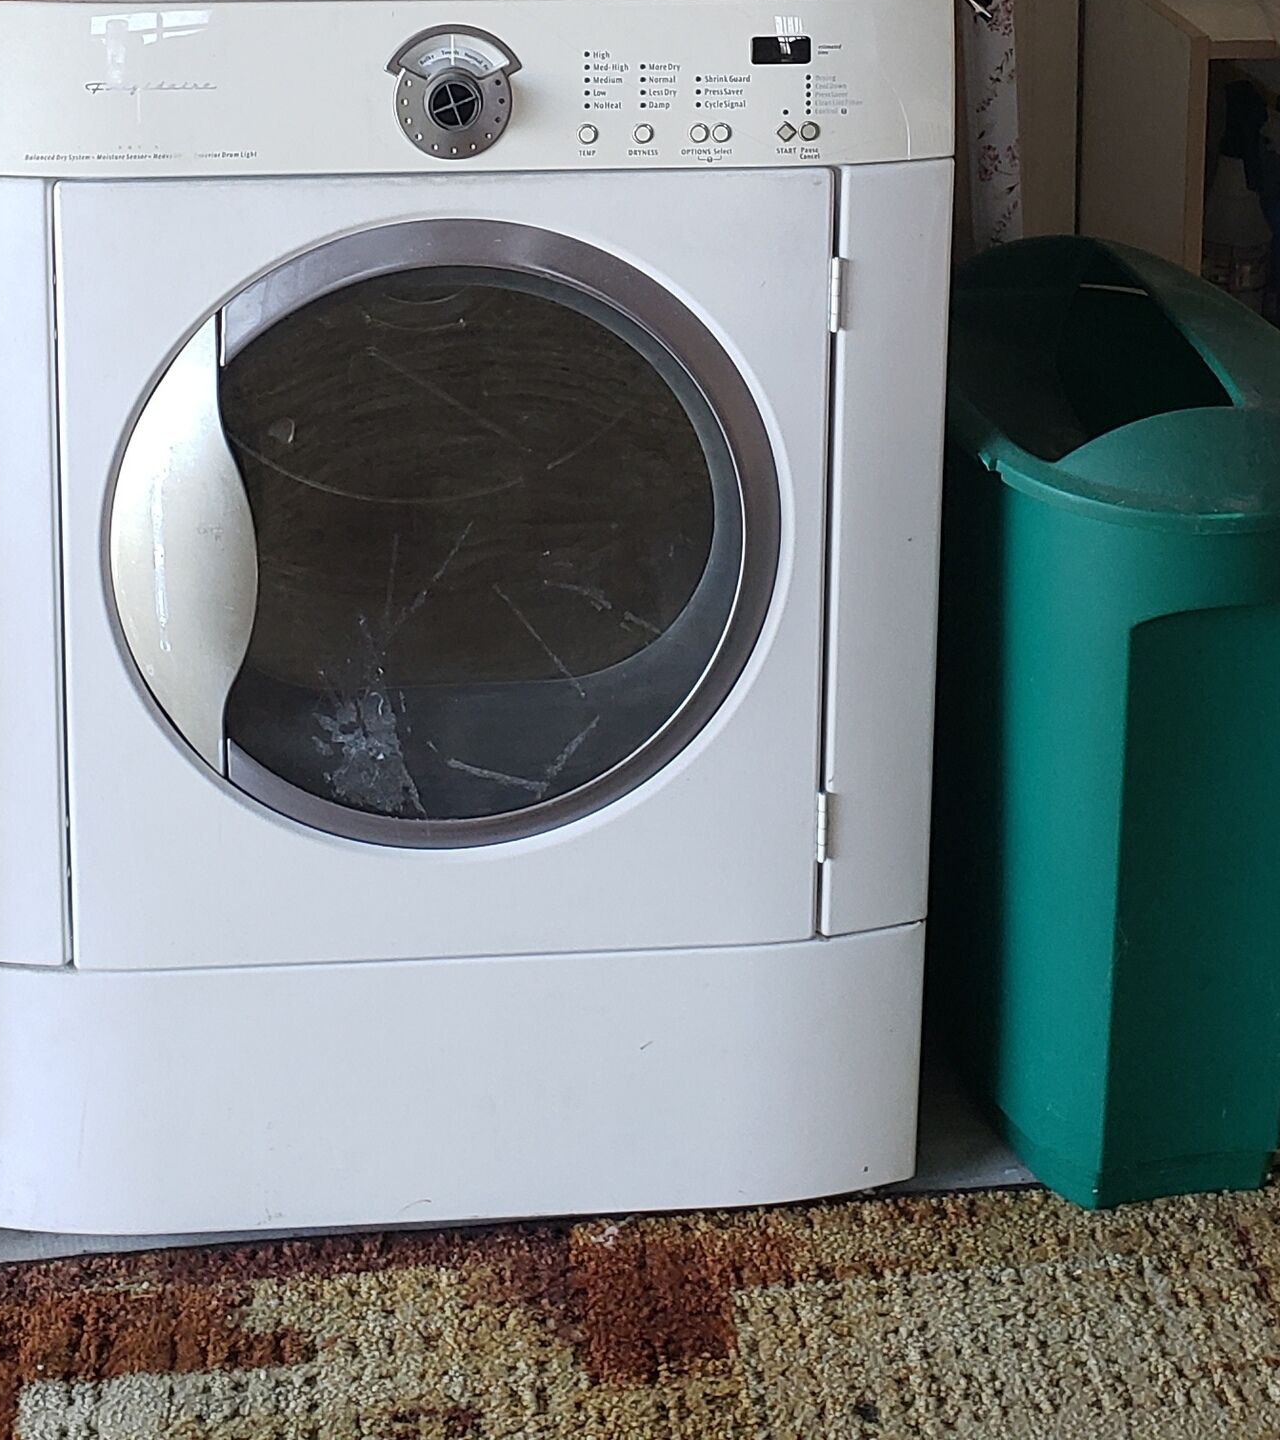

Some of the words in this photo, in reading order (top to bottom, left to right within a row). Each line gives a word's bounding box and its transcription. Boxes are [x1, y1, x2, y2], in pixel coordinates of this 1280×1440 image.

[593, 51, 610, 60] High
[593, 63, 629, 72] Med-High
[593, 76, 623, 84] Medium
[593, 89, 606, 97] Low
[648, 102, 671, 110] Damp
[56, 154, 68, 162] Dry
[68, 154, 91, 162] System
[240, 151, 258, 159] Light
[578, 149, 596, 157] TEMP
